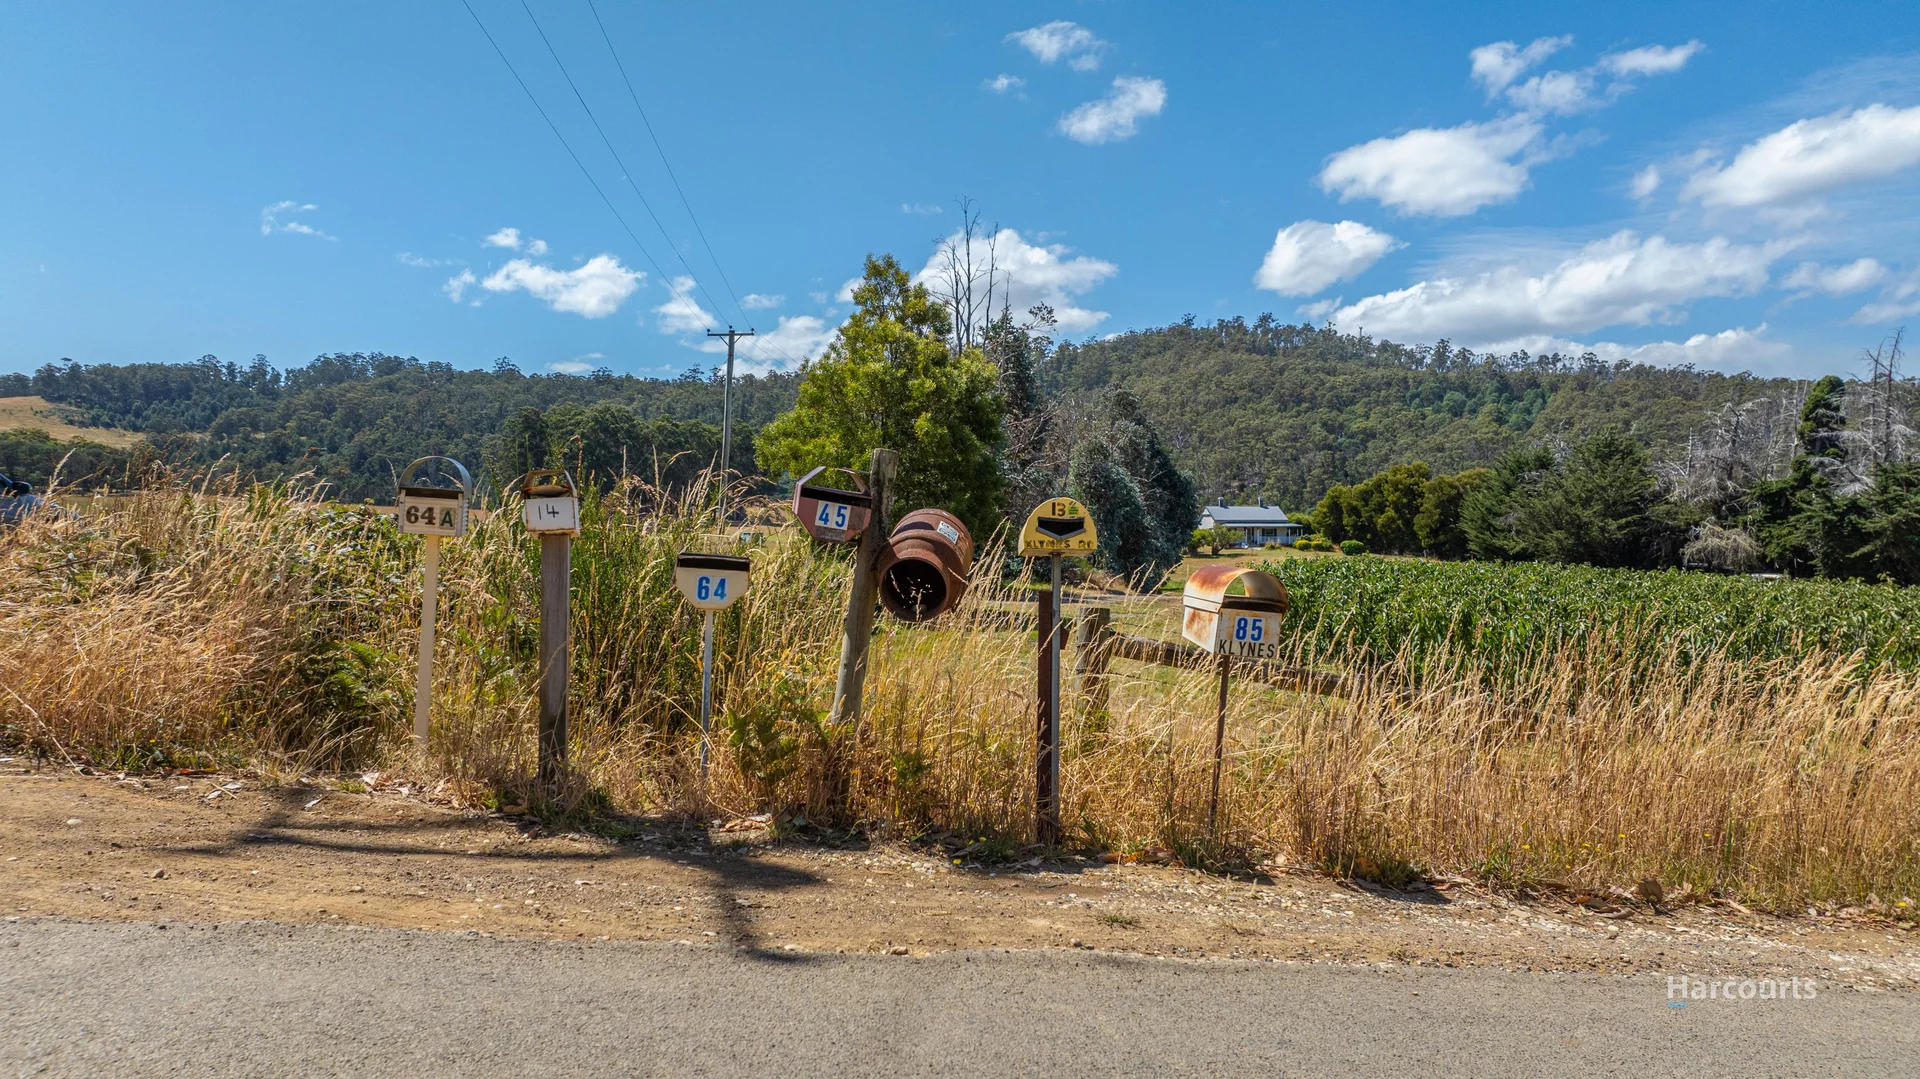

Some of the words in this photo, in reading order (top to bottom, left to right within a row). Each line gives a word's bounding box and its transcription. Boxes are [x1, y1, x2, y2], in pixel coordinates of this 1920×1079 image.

[538, 503, 560, 521] 14
[818, 503, 848, 528] 45
[697, 576, 727, 601] 64
[1235, 617, 1263, 642] 85
[1218, 639, 1275, 658] KLYNES
